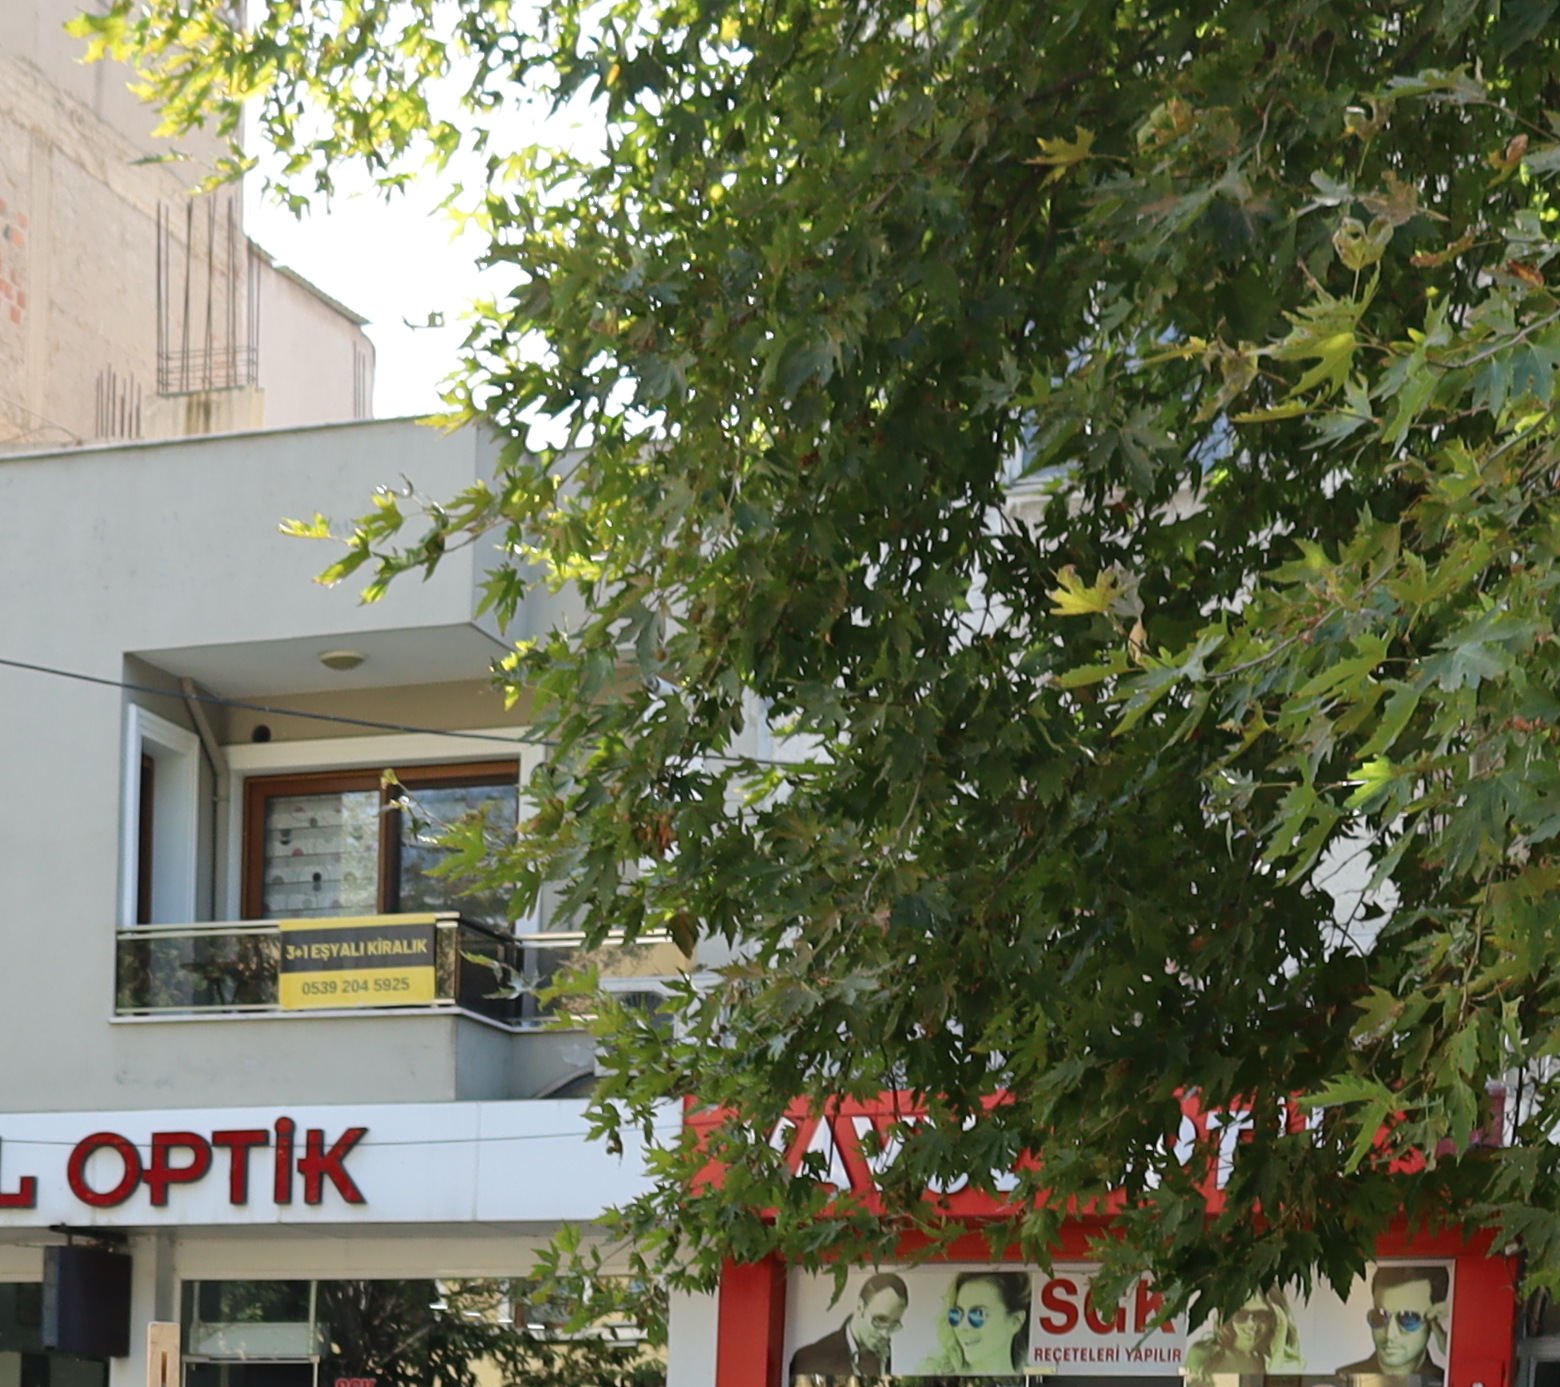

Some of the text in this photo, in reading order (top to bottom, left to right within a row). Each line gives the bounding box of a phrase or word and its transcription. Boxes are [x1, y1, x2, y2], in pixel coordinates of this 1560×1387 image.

[311, 940, 365, 961] EŞYALI
[368, 937, 429, 956] KİRALIK
[302, 977, 410, 995] 0539 204 5925
[66, 1116, 371, 1208] OPTİK
[1034, 1343, 1183, 1364] REÇETELERİ YAPILIR
